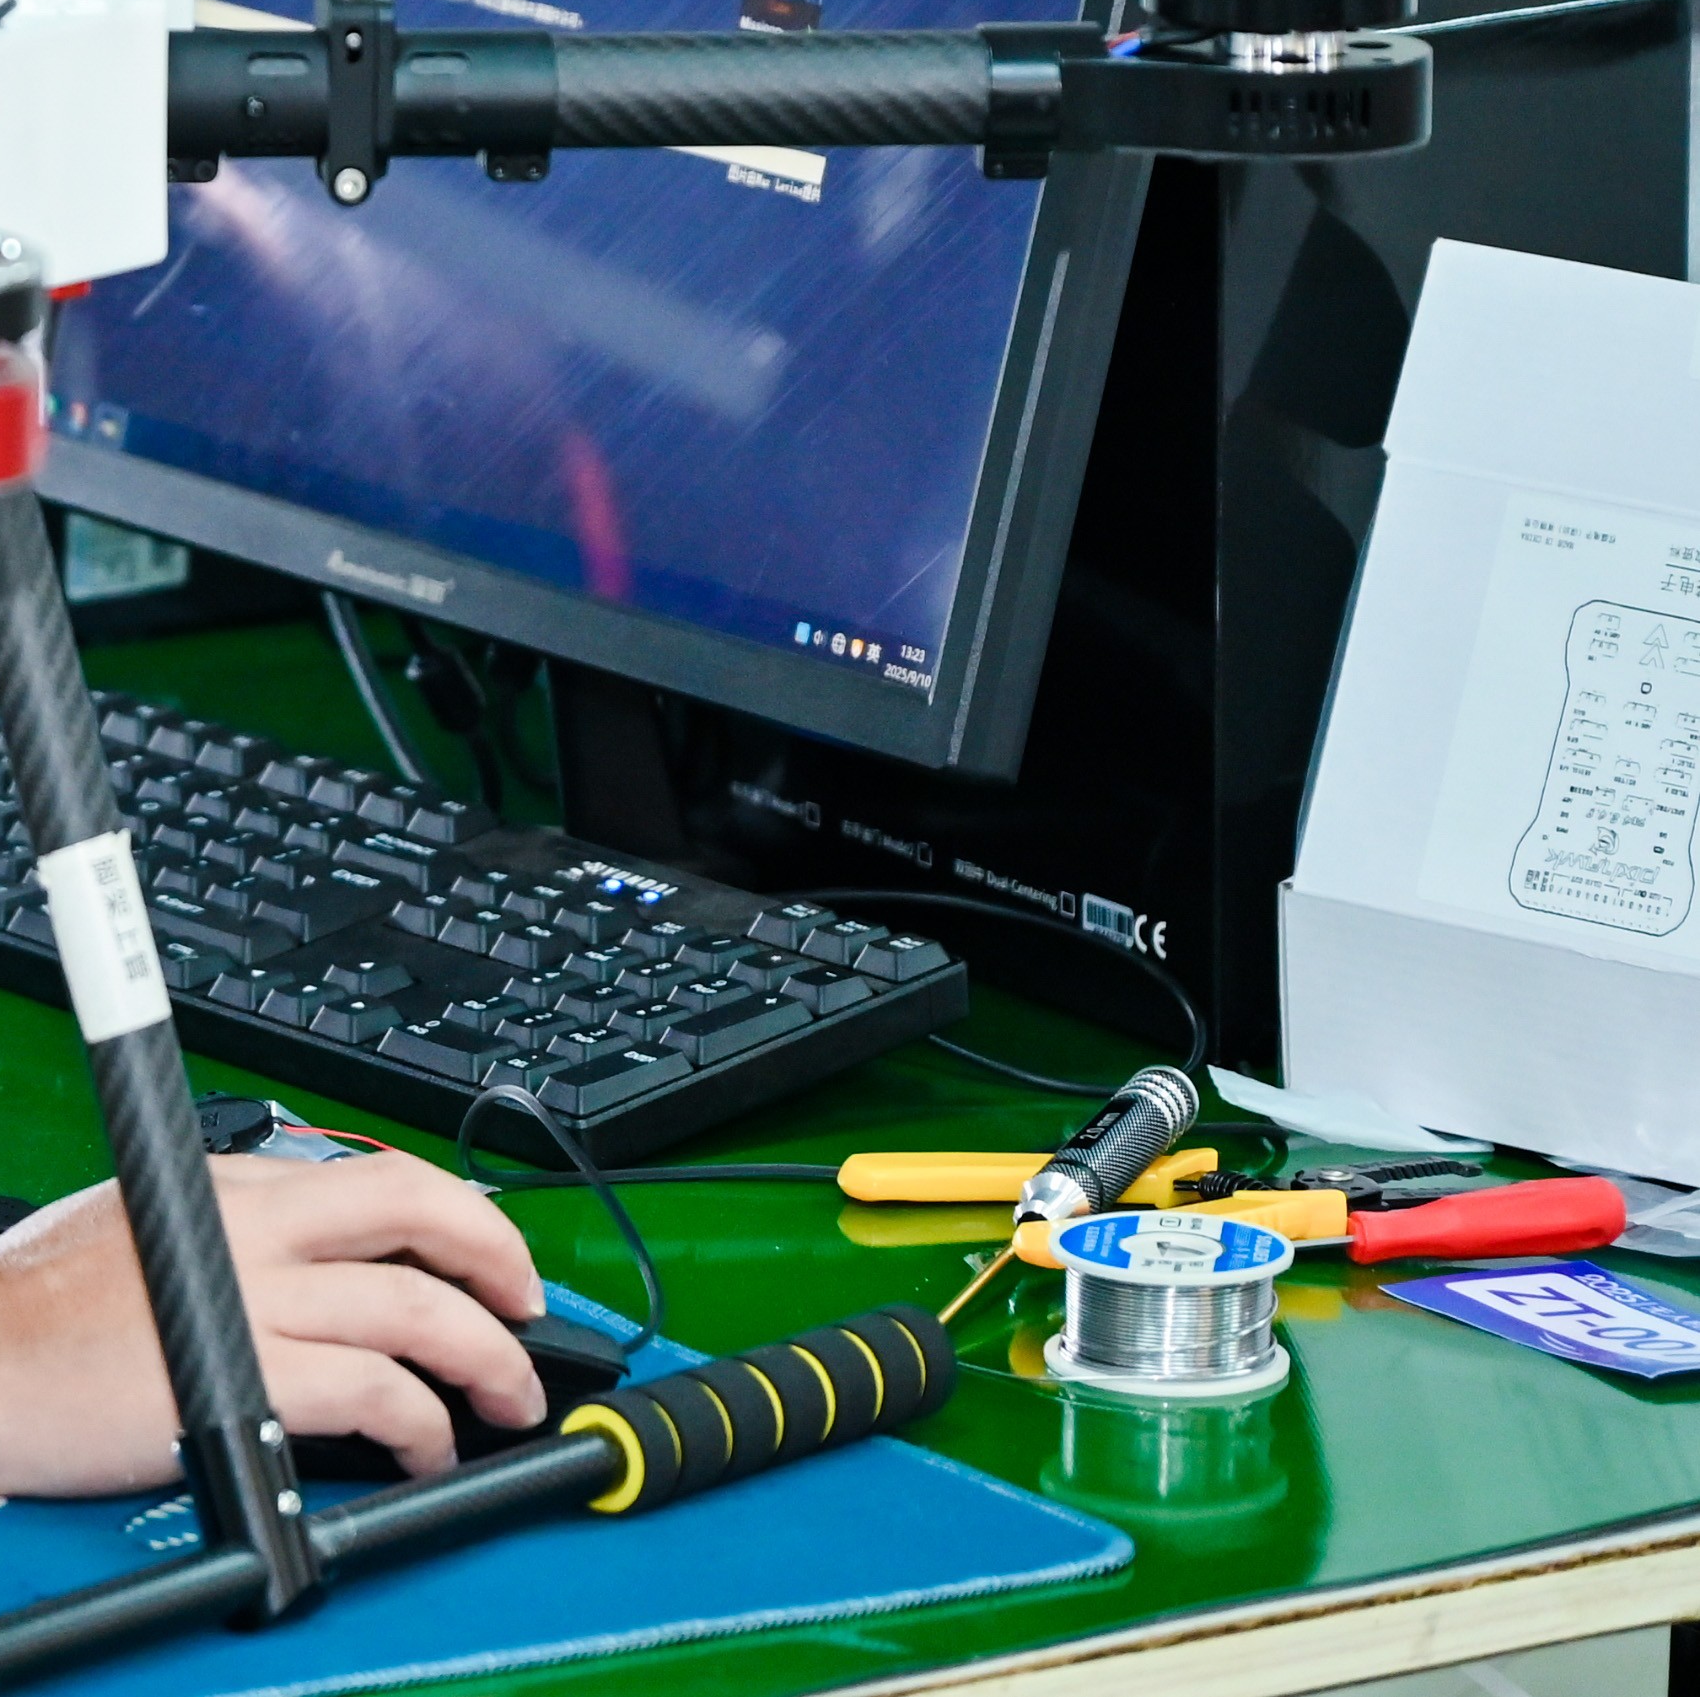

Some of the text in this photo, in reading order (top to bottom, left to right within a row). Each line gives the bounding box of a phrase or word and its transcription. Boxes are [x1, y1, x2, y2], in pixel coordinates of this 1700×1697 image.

[1660, 573, 1700, 597] 电子
[900, 644, 926, 664] 13:23
[884, 663, 932, 687] 2025/9/10
[1134, 913, 1167, 960] CE
[1485, 1286, 1700, 1356] ZT-00
